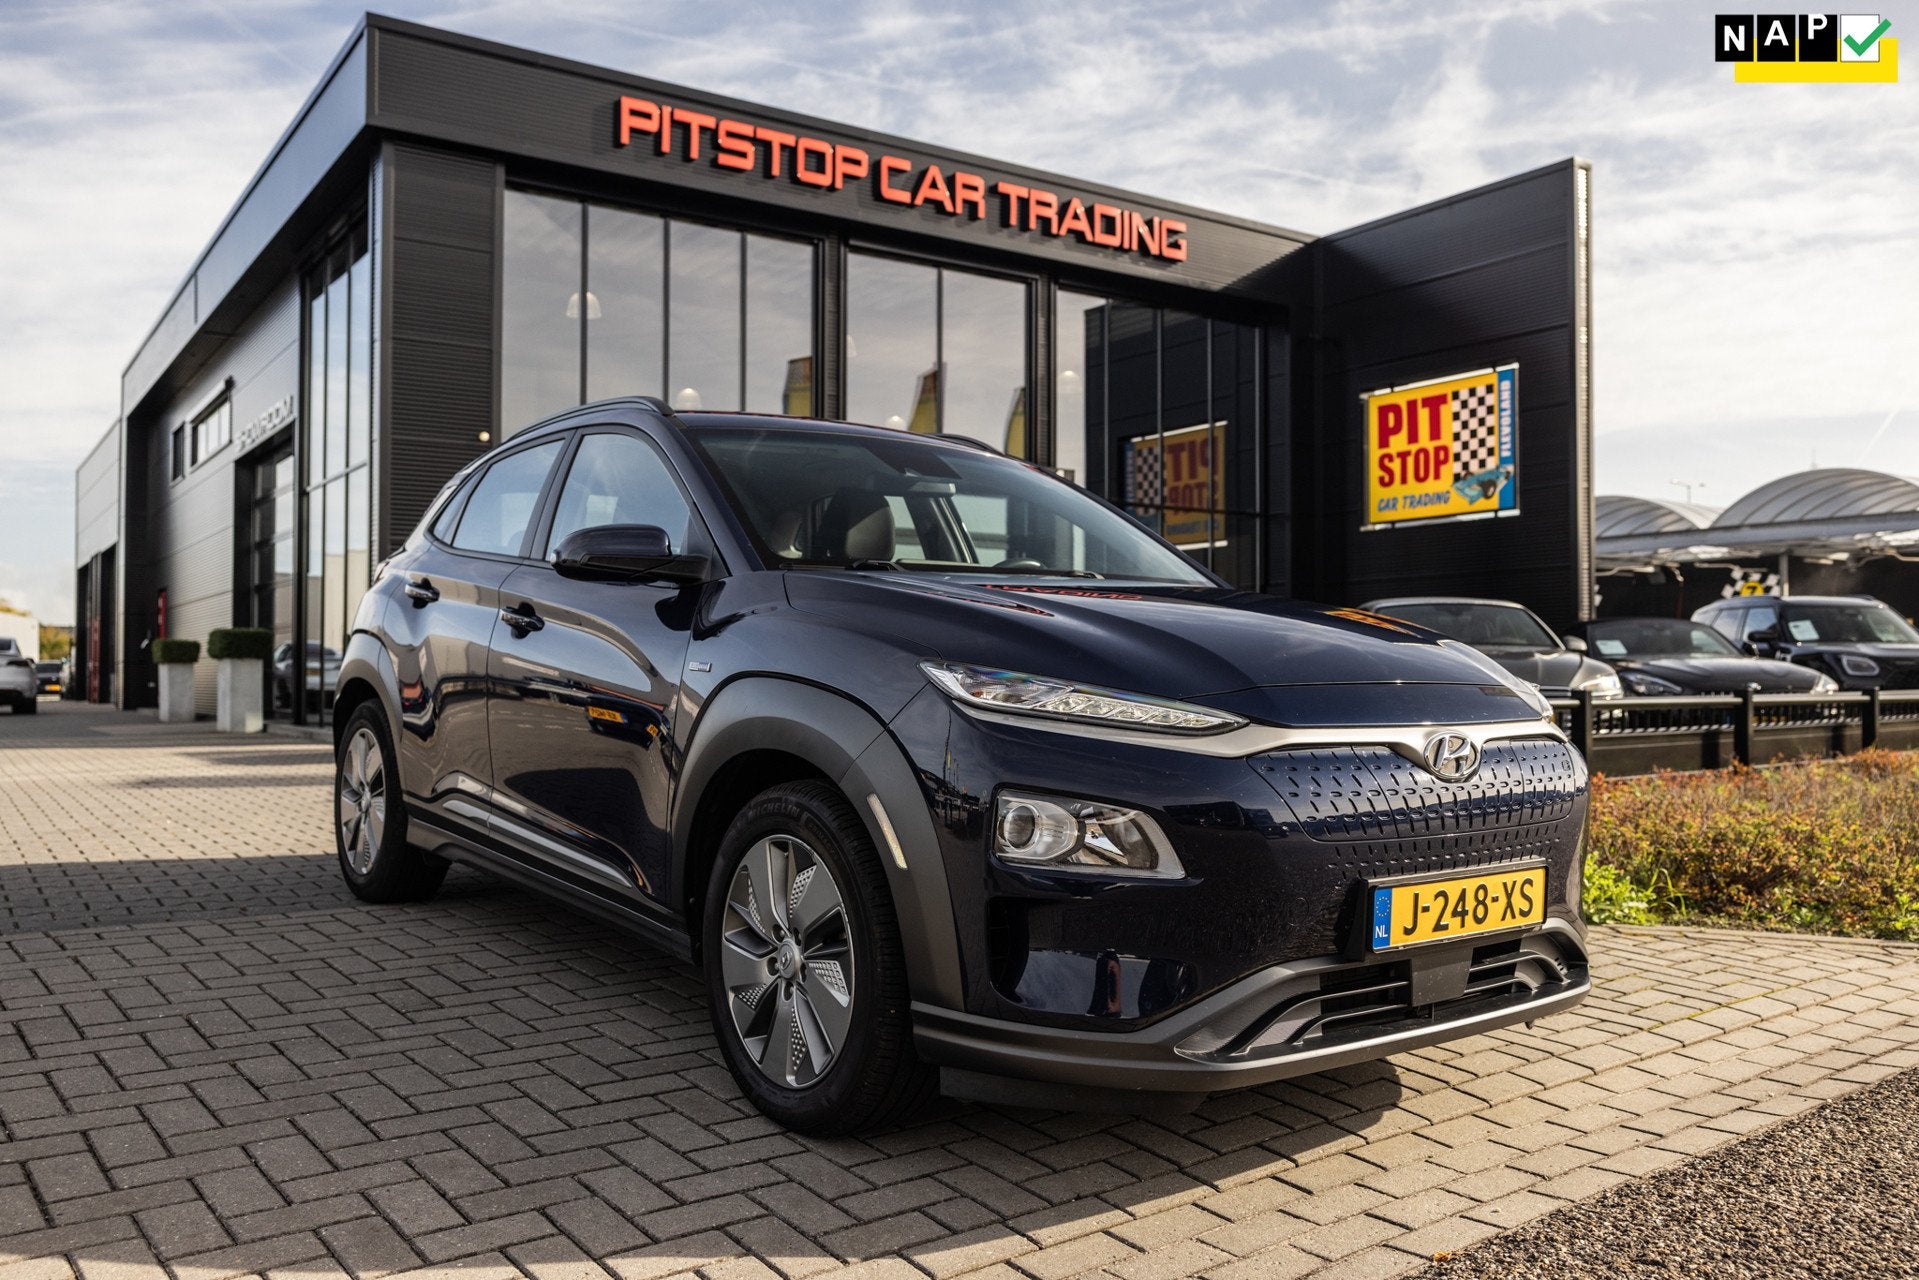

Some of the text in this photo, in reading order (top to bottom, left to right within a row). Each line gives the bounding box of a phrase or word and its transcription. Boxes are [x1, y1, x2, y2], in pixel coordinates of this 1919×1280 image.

[620, 95, 1188, 262] PITSTOP CAR TRADING
[1377, 393, 1449, 450] PIT
[1377, 445, 1450, 488] STOP
[1377, 490, 1451, 512] CAR TRADING
[1403, 877, 1534, 936] J-248-XS
[1375, 925, 1388, 939] NL
